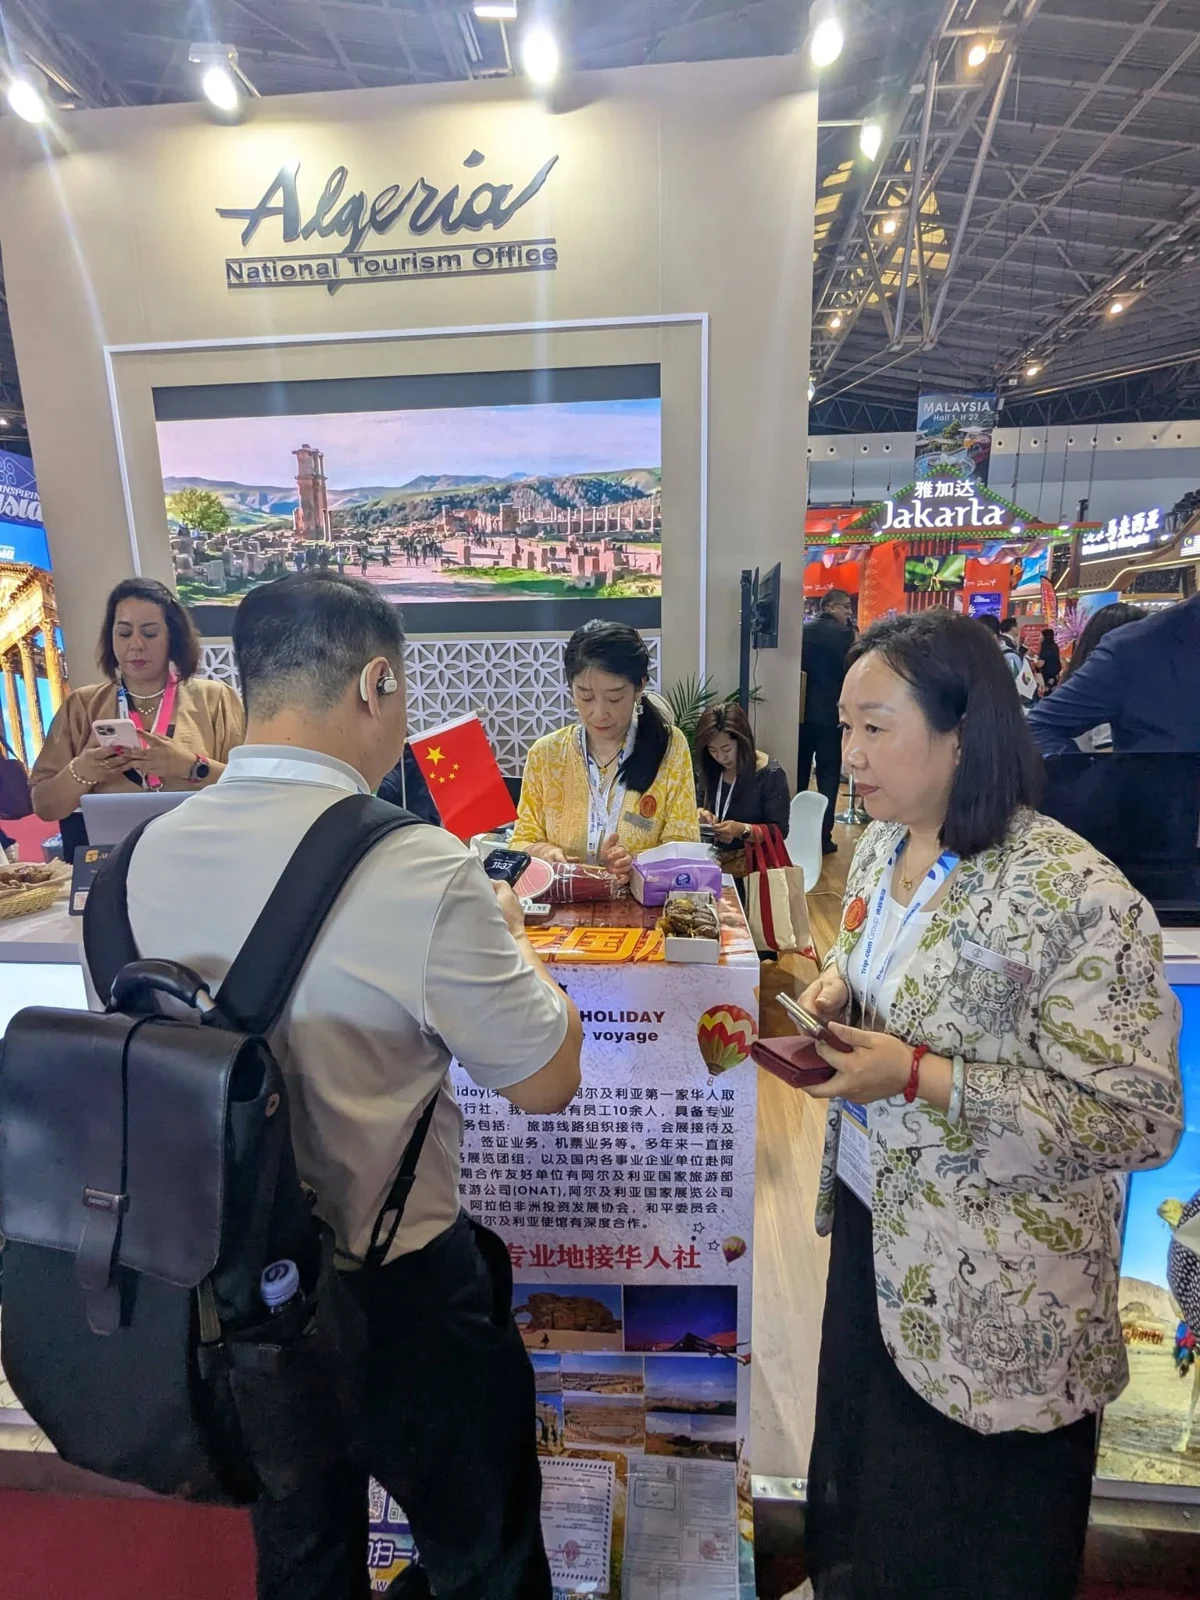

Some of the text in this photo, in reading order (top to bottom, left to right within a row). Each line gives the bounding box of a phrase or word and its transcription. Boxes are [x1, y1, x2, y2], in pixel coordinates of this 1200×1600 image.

[215, 150, 559, 295] Algeria
[225, 244, 559, 283] National Tourism Office
[923, 401, 990, 413] MALAYSIA
[933, 413, 949, 421] Hall
[914, 479, 975, 498] 雅加达
[882, 498, 1006, 530] Jakarta
[492, 861, 513, 870] 11:37
[860, 941, 873, 975] Trip.com
[868, 917, 881, 942] Group
[580, 1010, 665, 1023] HOLIDAY
[592, 1031, 659, 1042] voyage
[507, 1242, 701, 1270] 专业地接华人社
